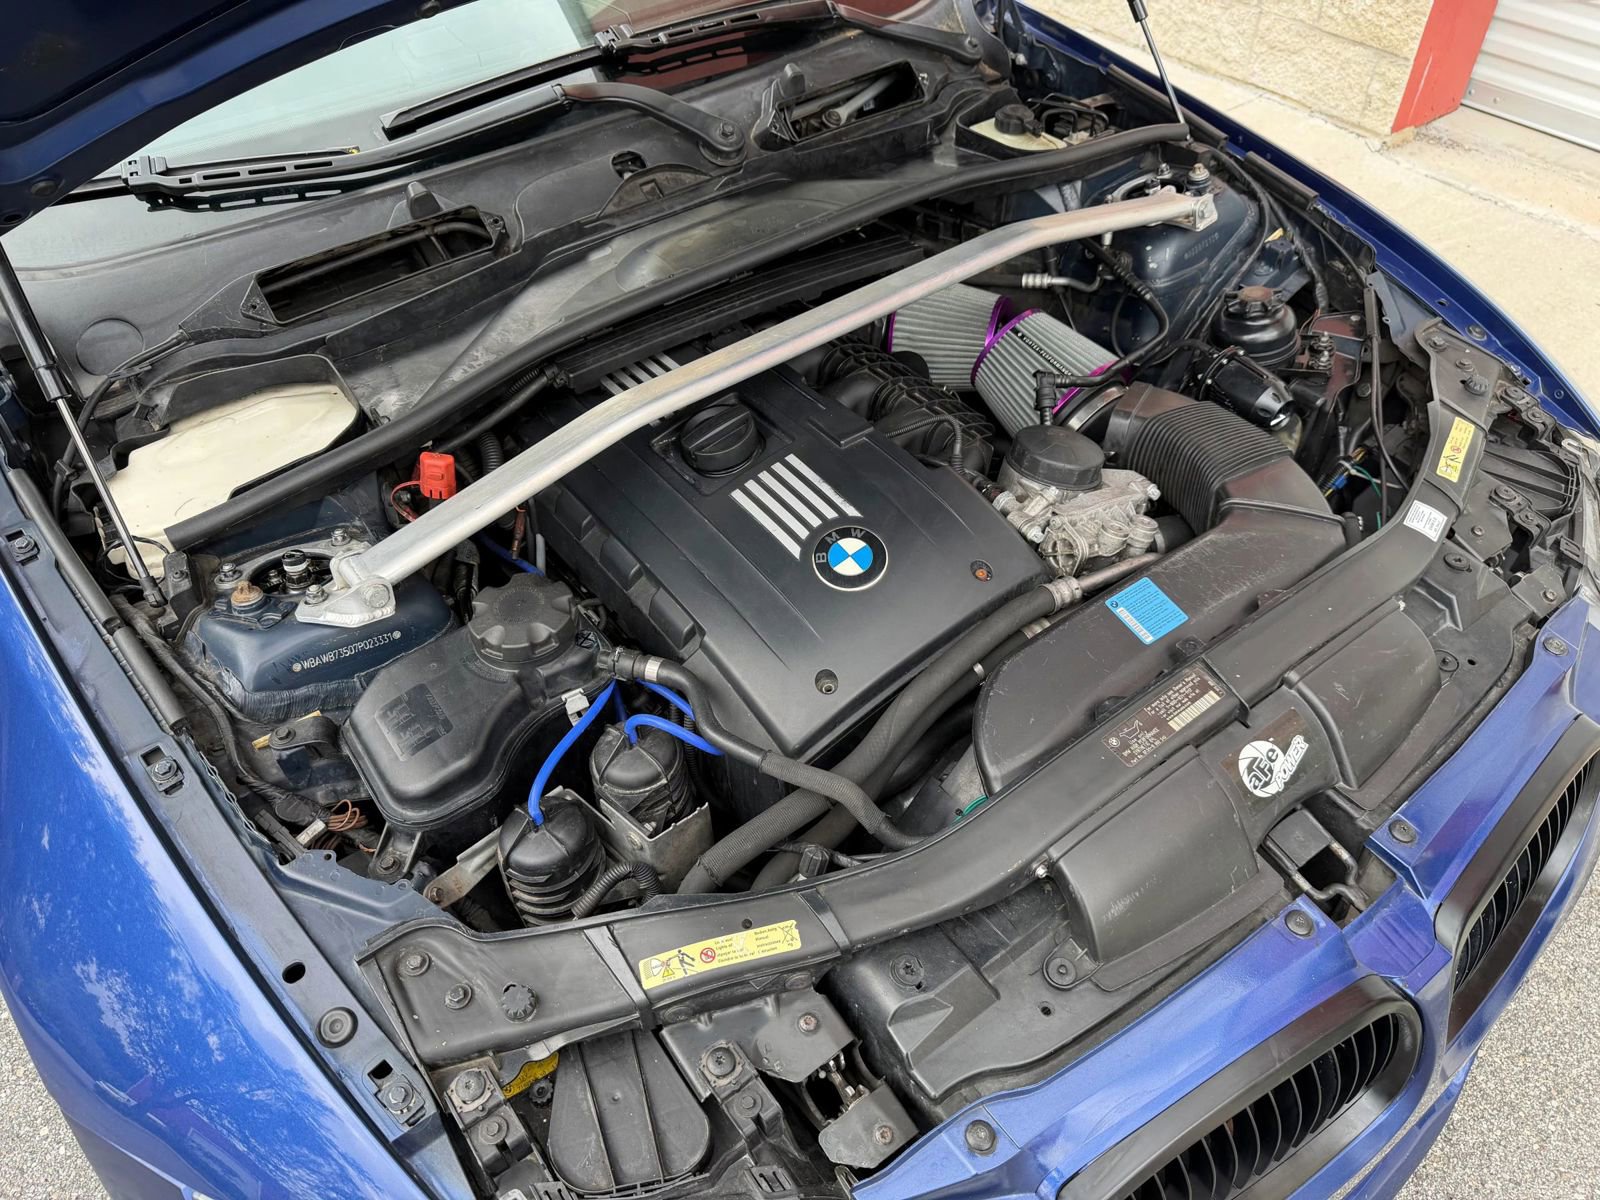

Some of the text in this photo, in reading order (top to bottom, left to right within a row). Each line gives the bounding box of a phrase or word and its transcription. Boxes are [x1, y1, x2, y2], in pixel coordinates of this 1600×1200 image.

[815, 527, 866, 563] BMW
[1249, 735, 1309, 791] aFe POWER
